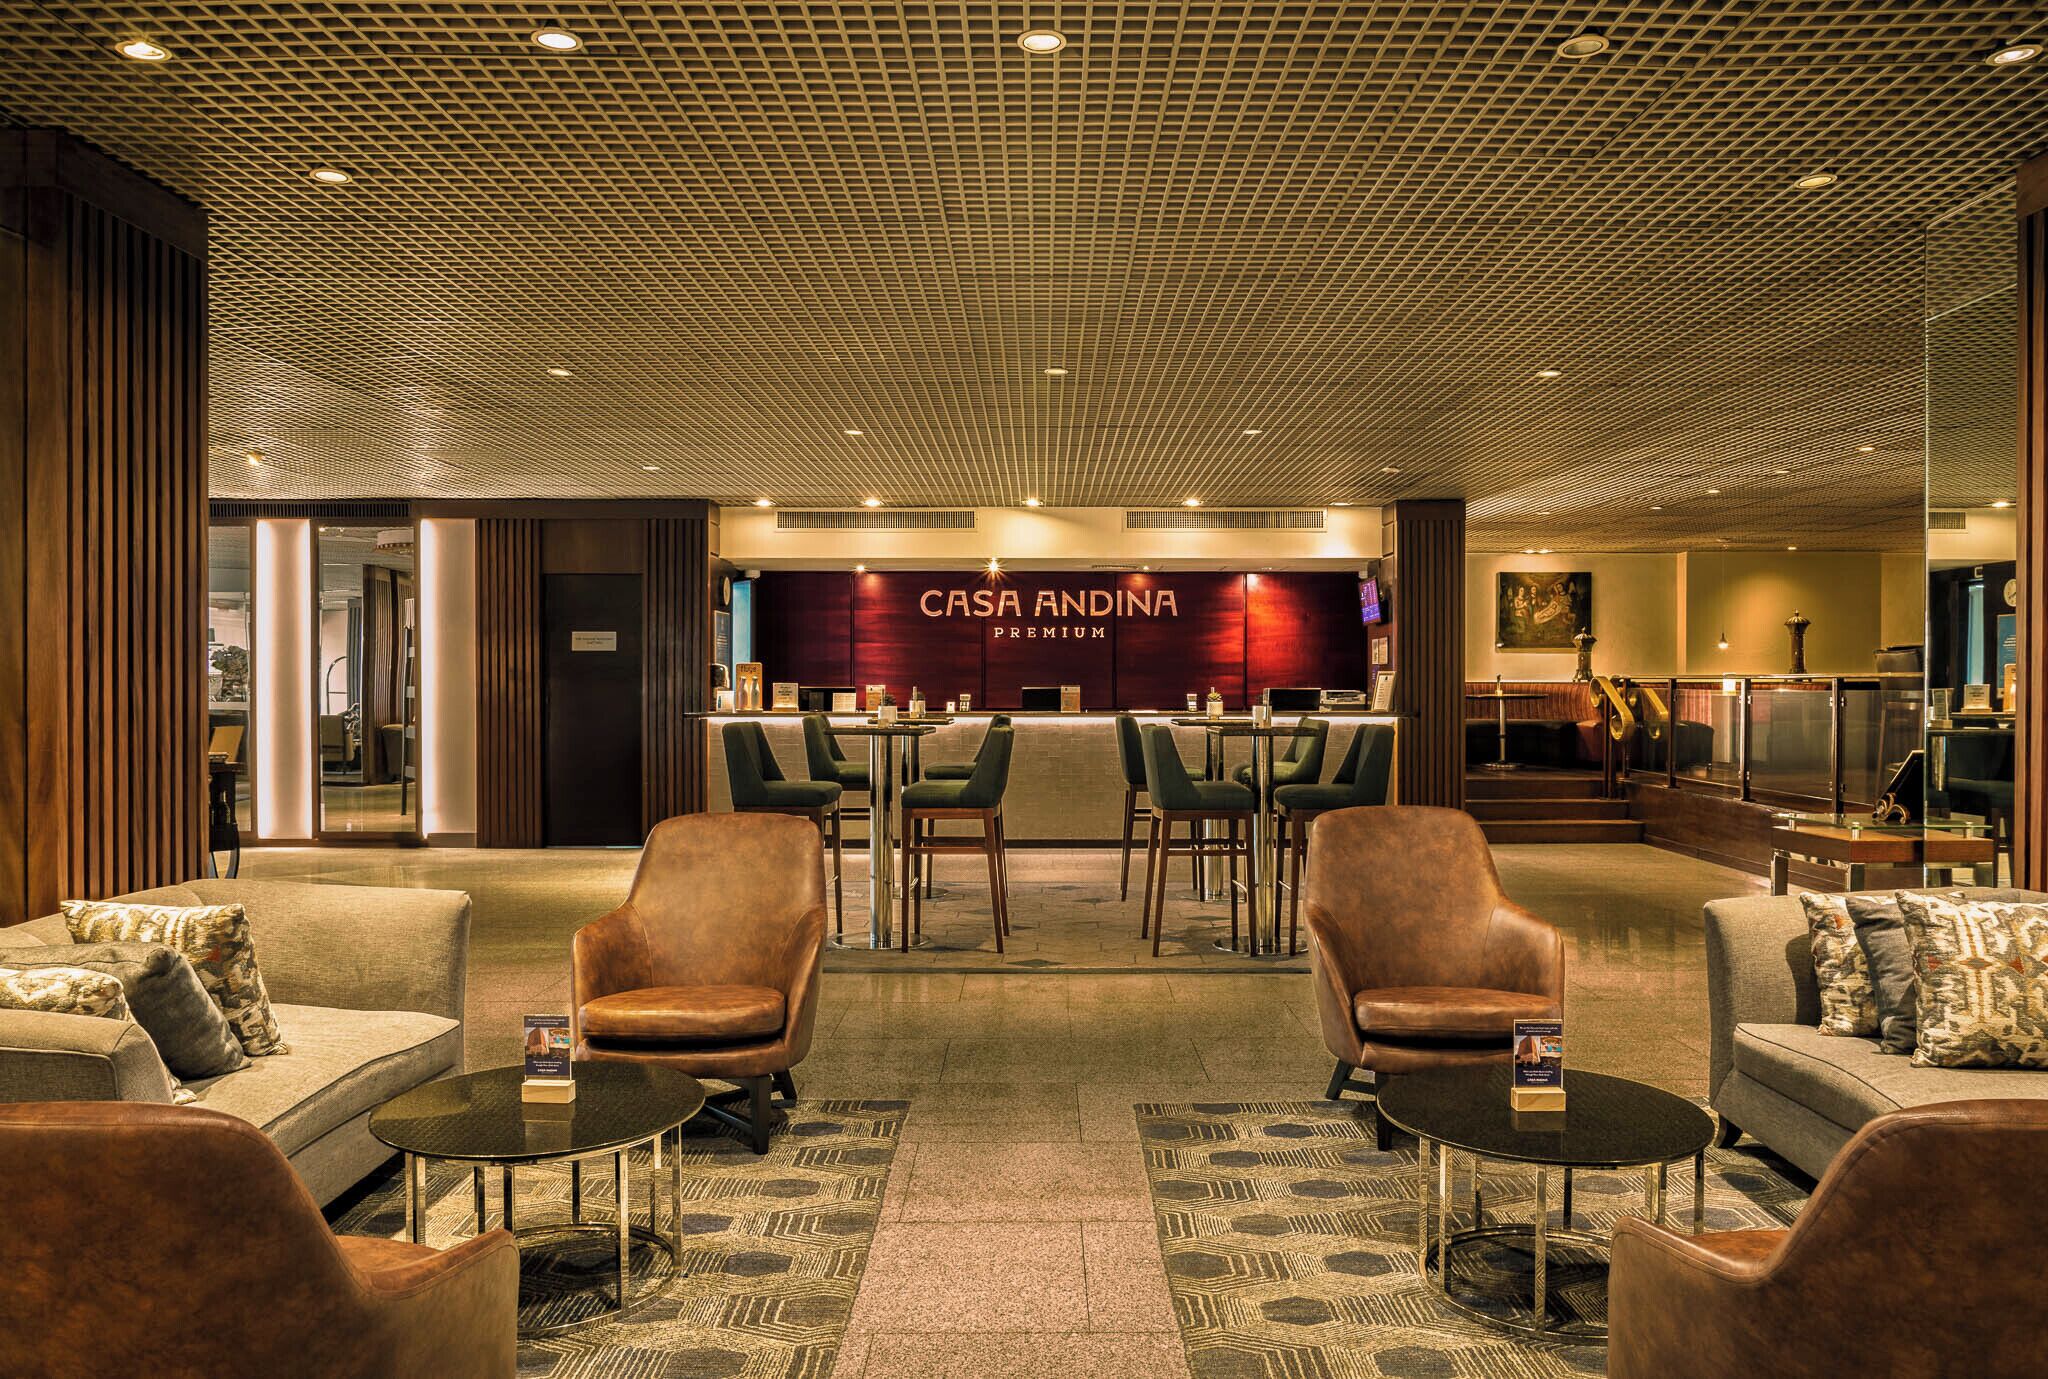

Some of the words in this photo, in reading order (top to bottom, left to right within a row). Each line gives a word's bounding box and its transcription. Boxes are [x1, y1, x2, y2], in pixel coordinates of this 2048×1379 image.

[920, 590, 1021, 617] CASA
[1034, 590, 1178, 617] ANDINA
[993, 627, 1105, 638] PREMIUM
